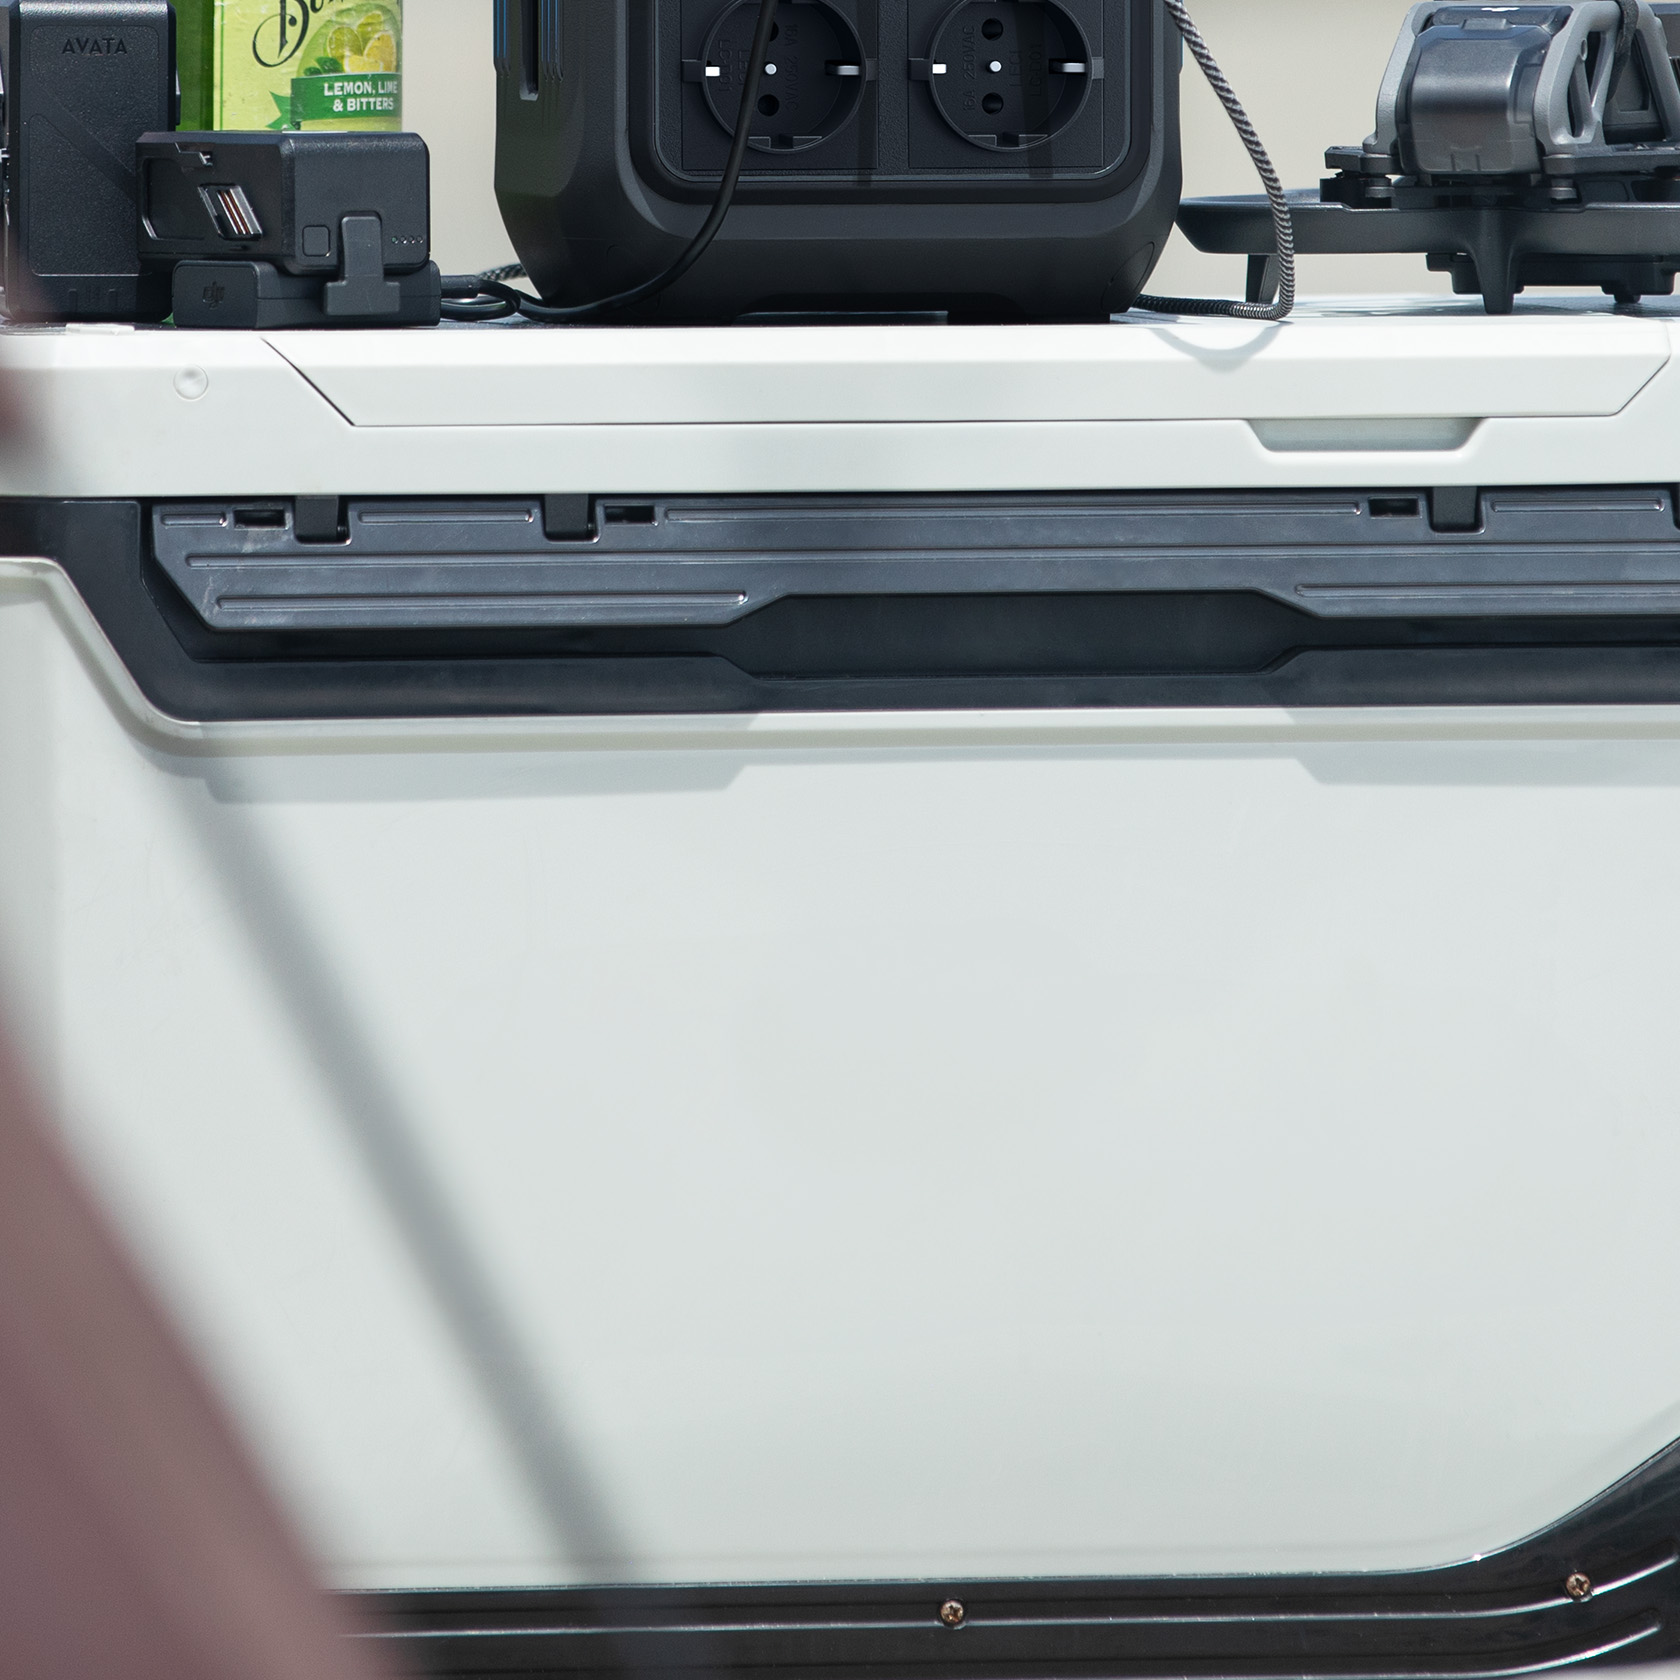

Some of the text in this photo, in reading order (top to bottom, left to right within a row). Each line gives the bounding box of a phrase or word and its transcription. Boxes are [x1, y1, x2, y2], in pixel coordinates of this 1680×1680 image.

[61, 37, 128, 55] AVATA
[962, 25, 978, 81] 250VAC
[324, 80, 398, 96] LEMON, LIME
[784, 55, 800, 111] 250VAC
[333, 96, 394, 111] & BITTERS
